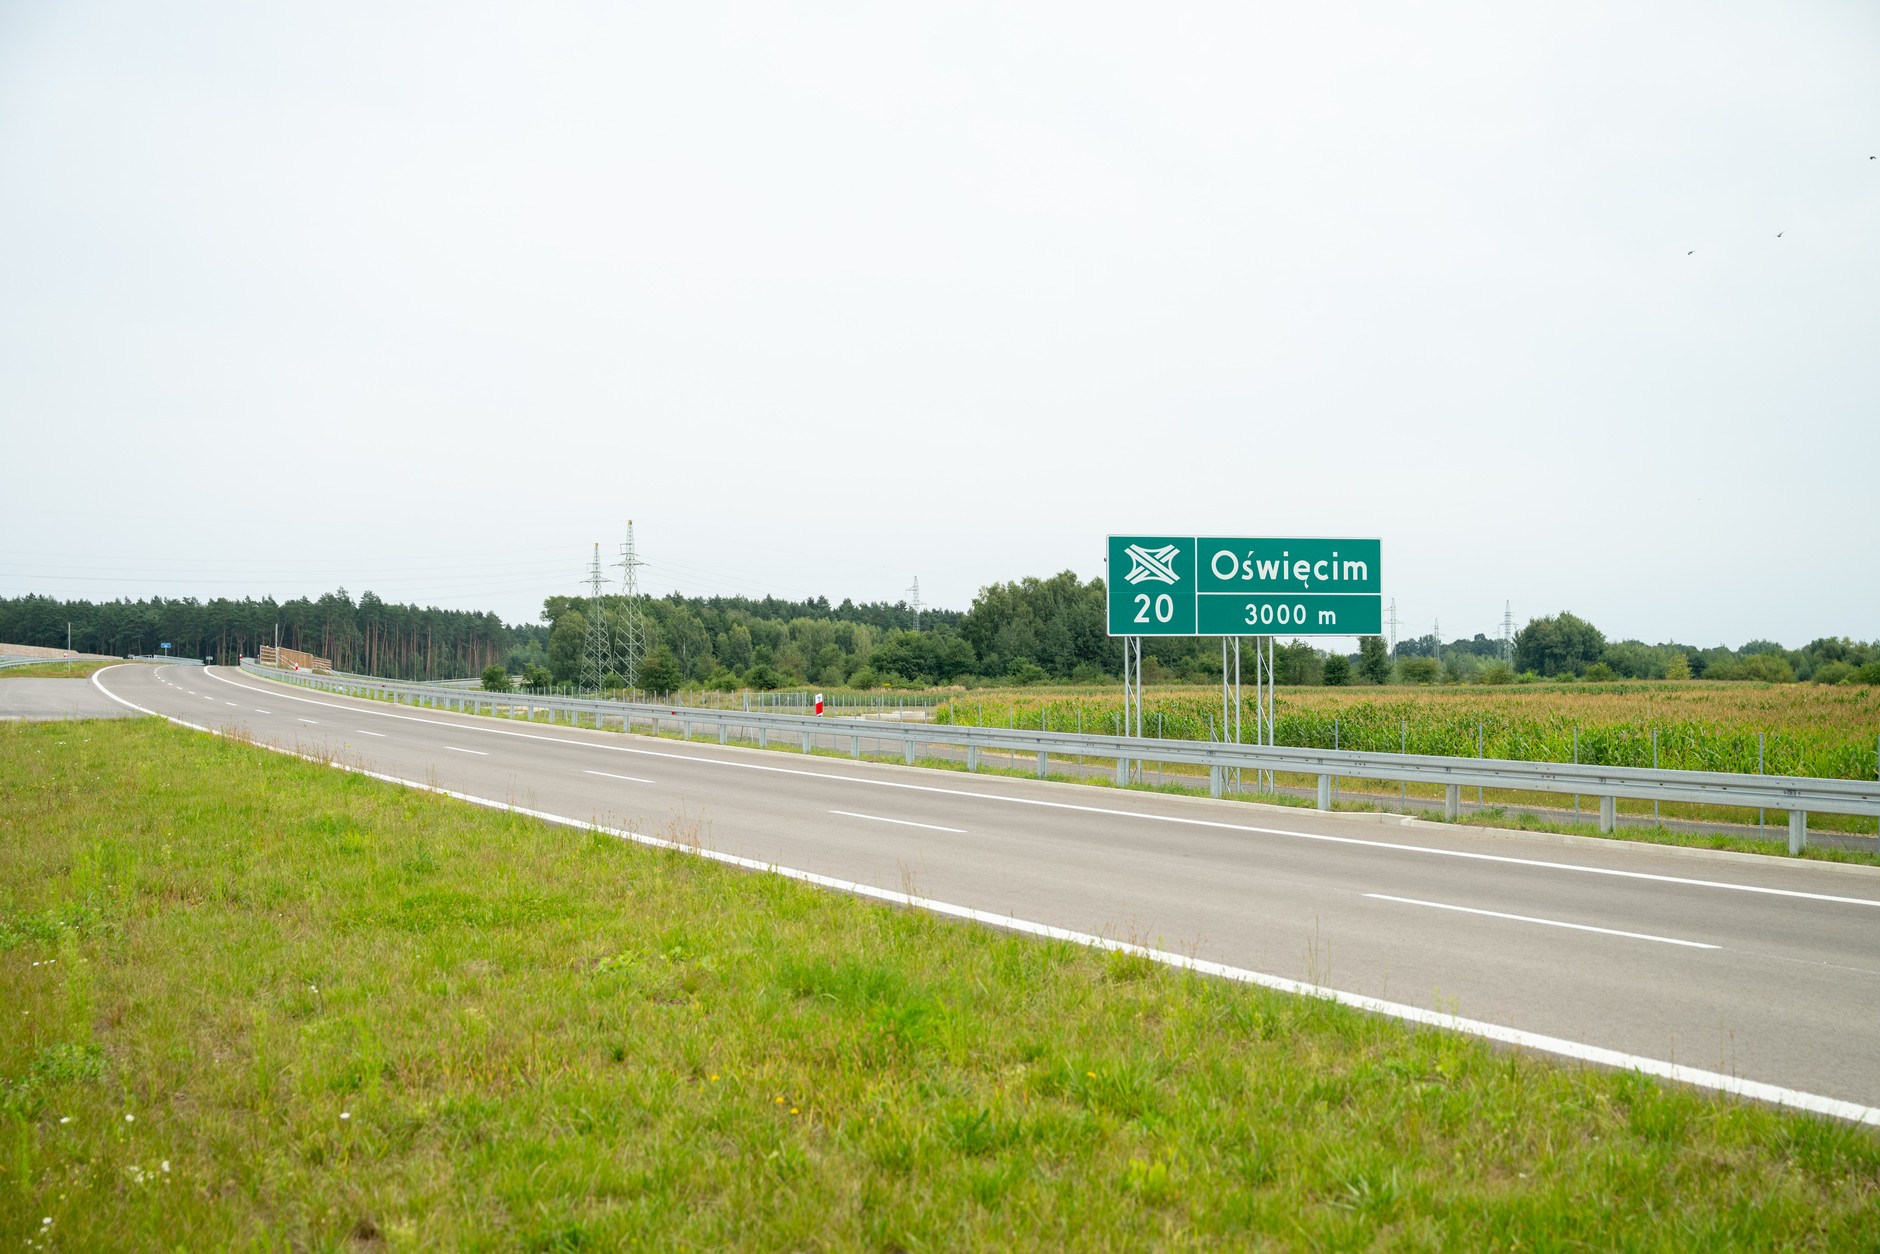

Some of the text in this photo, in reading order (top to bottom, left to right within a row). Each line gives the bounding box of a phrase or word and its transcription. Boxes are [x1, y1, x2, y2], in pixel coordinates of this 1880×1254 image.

[1211, 549, 1368, 589] Oświęcim
[1133, 593, 1174, 623] 20
[1244, 603, 1336, 625] 3000 m
